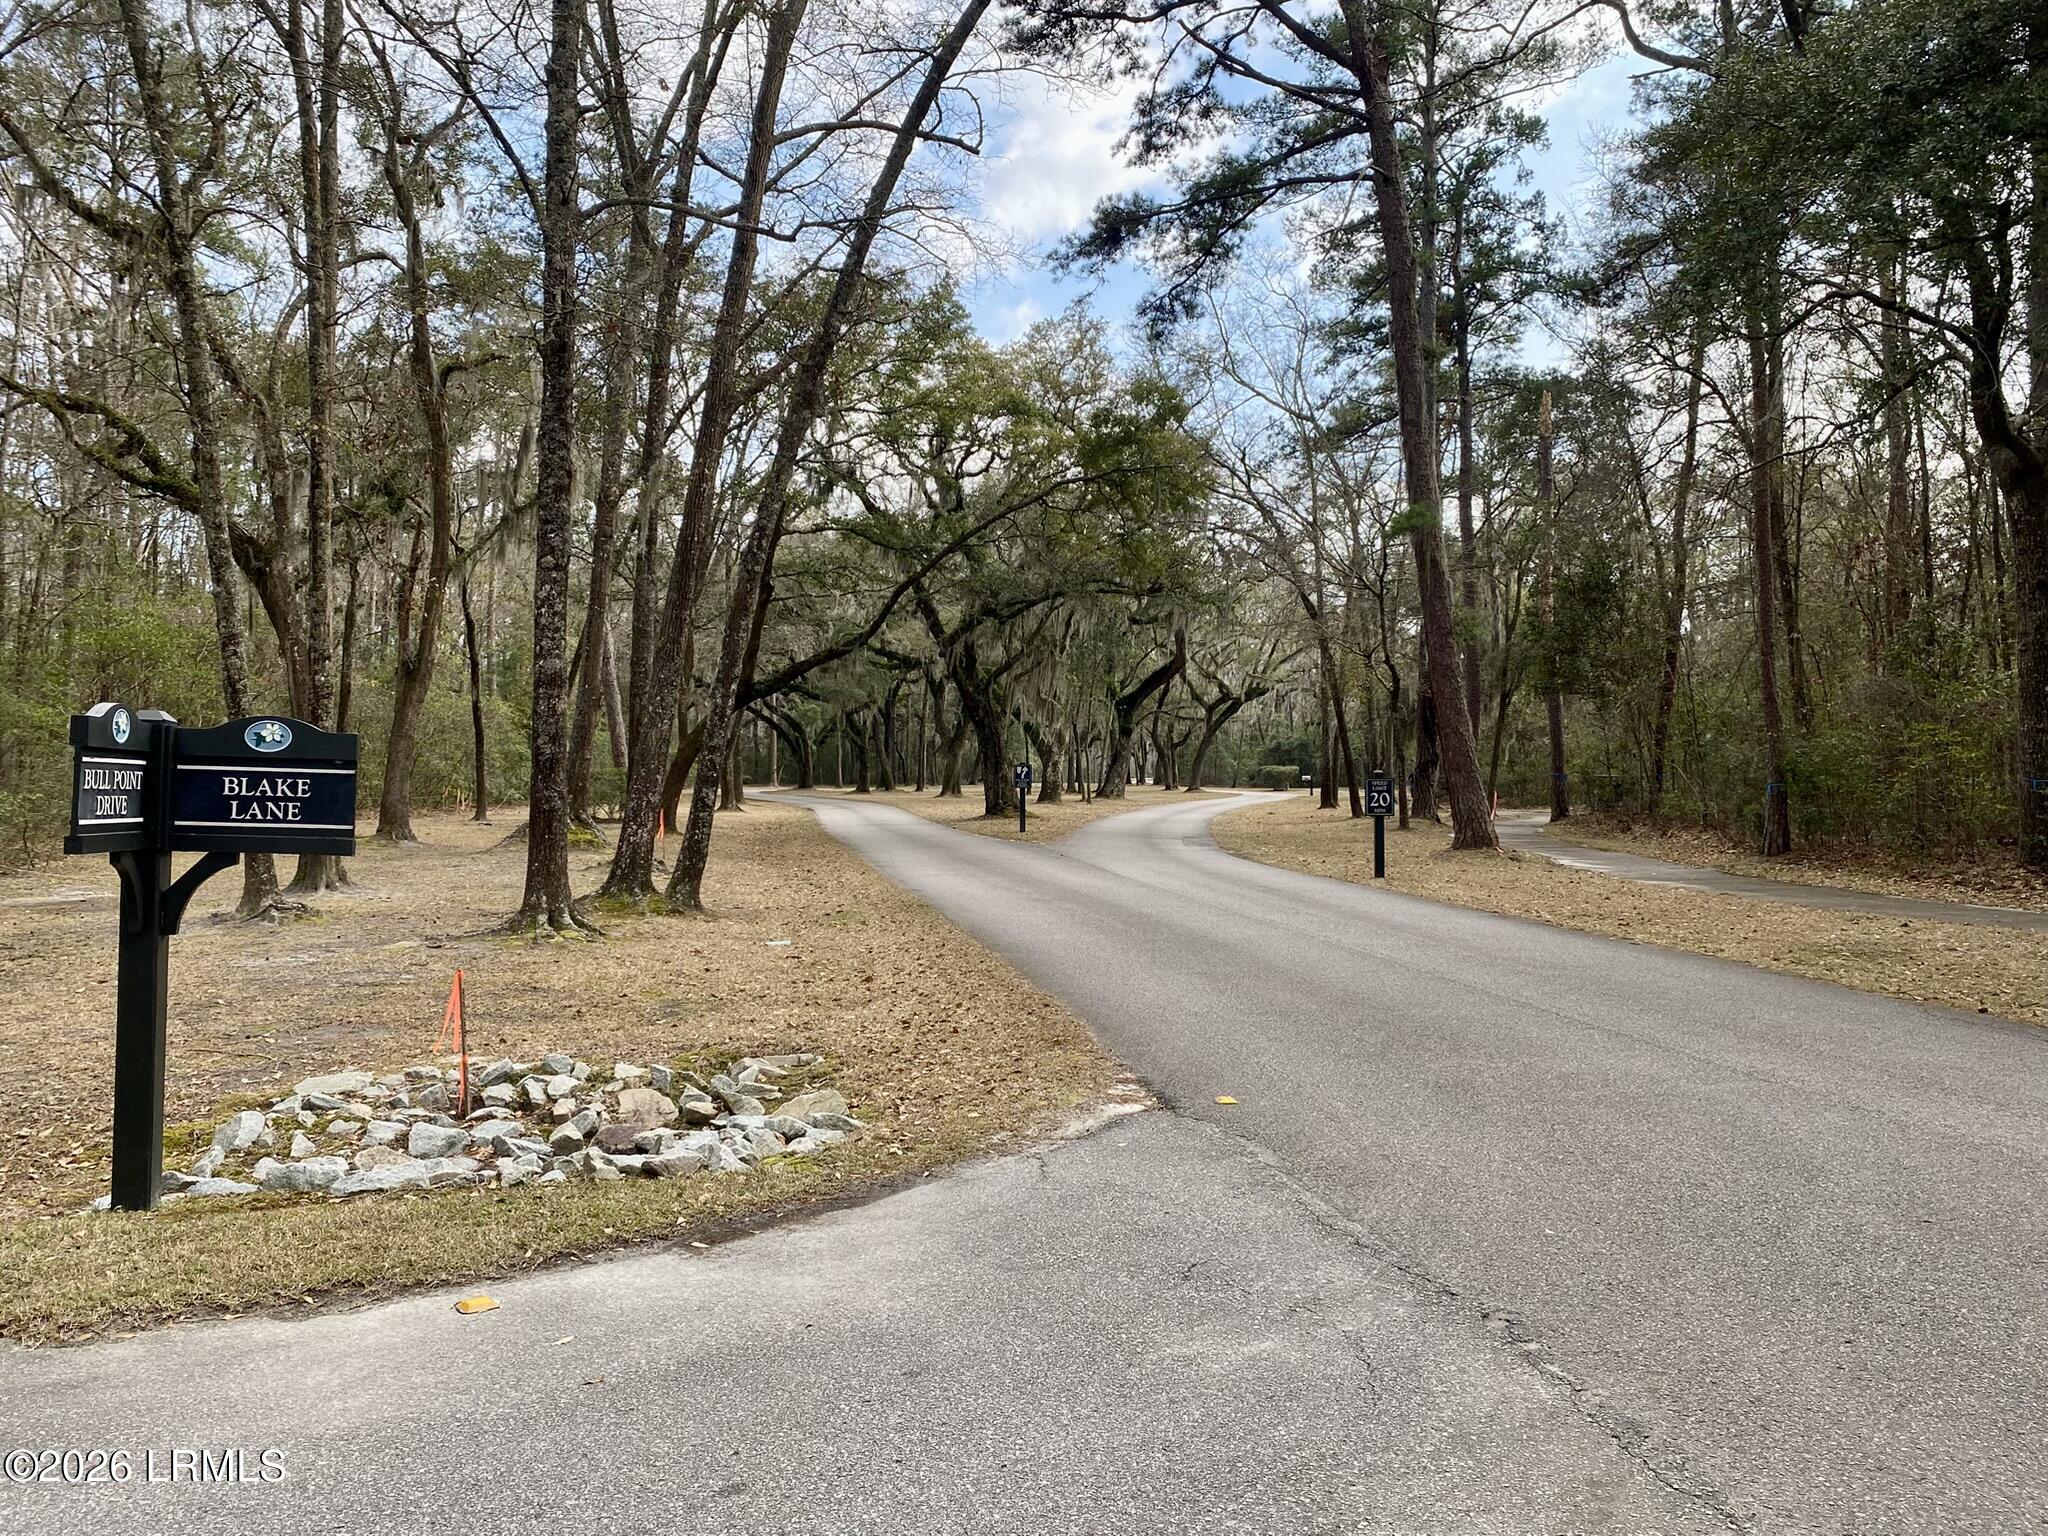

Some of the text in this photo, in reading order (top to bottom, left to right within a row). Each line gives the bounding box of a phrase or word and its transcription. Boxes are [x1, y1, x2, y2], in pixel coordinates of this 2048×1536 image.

[84, 768, 143, 791] BULL POINT
[222, 776, 311, 798] BLAKE
[95, 795, 128, 816] DRIVE
[1370, 792, 1390, 807] 20
[230, 801, 302, 821] LANE
